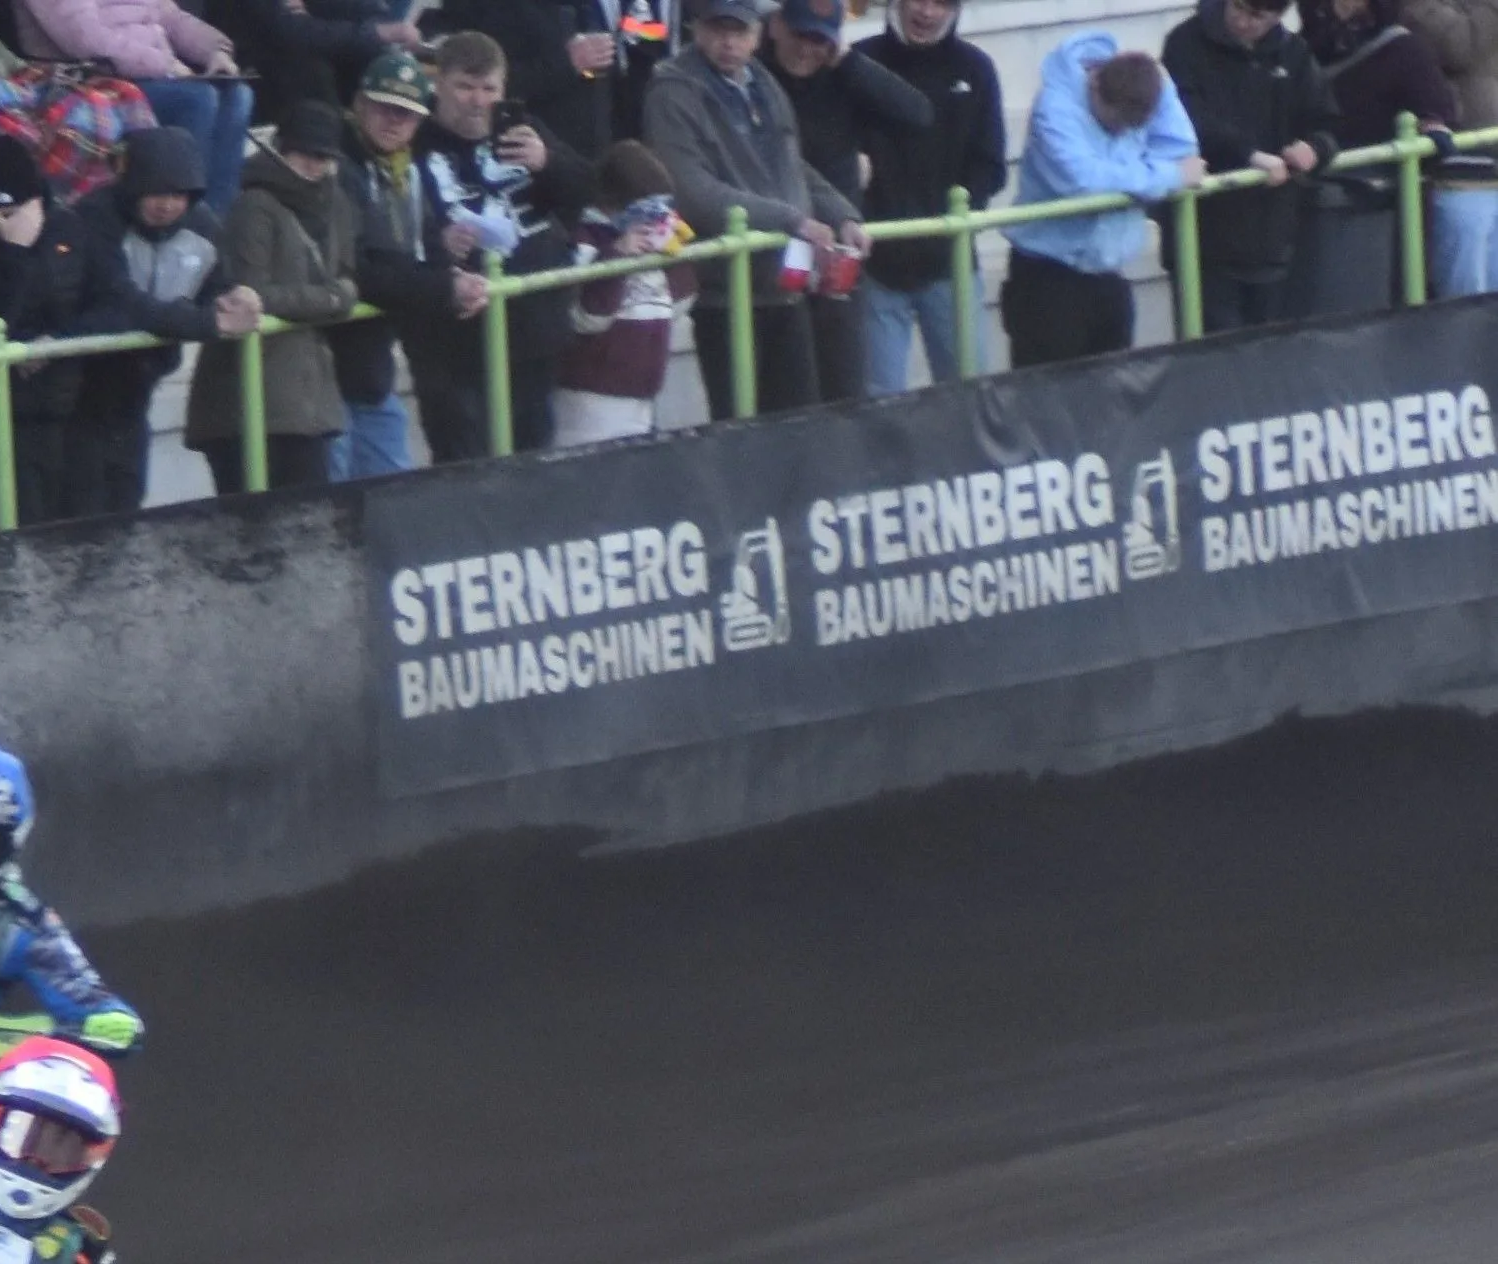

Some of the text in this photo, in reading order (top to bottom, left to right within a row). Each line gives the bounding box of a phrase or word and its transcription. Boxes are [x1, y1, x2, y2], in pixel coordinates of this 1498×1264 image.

[1198, 384, 1495, 503] STERNBERG
[809, 452, 1115, 574] STERNBERG
[1203, 469, 1498, 573] BAUMASCHINEN
[391, 520, 709, 646] STERNBERG
[814, 539, 1120, 646] BAUMASCHINEN
[399, 609, 715, 720] BAUMASCHINEN
